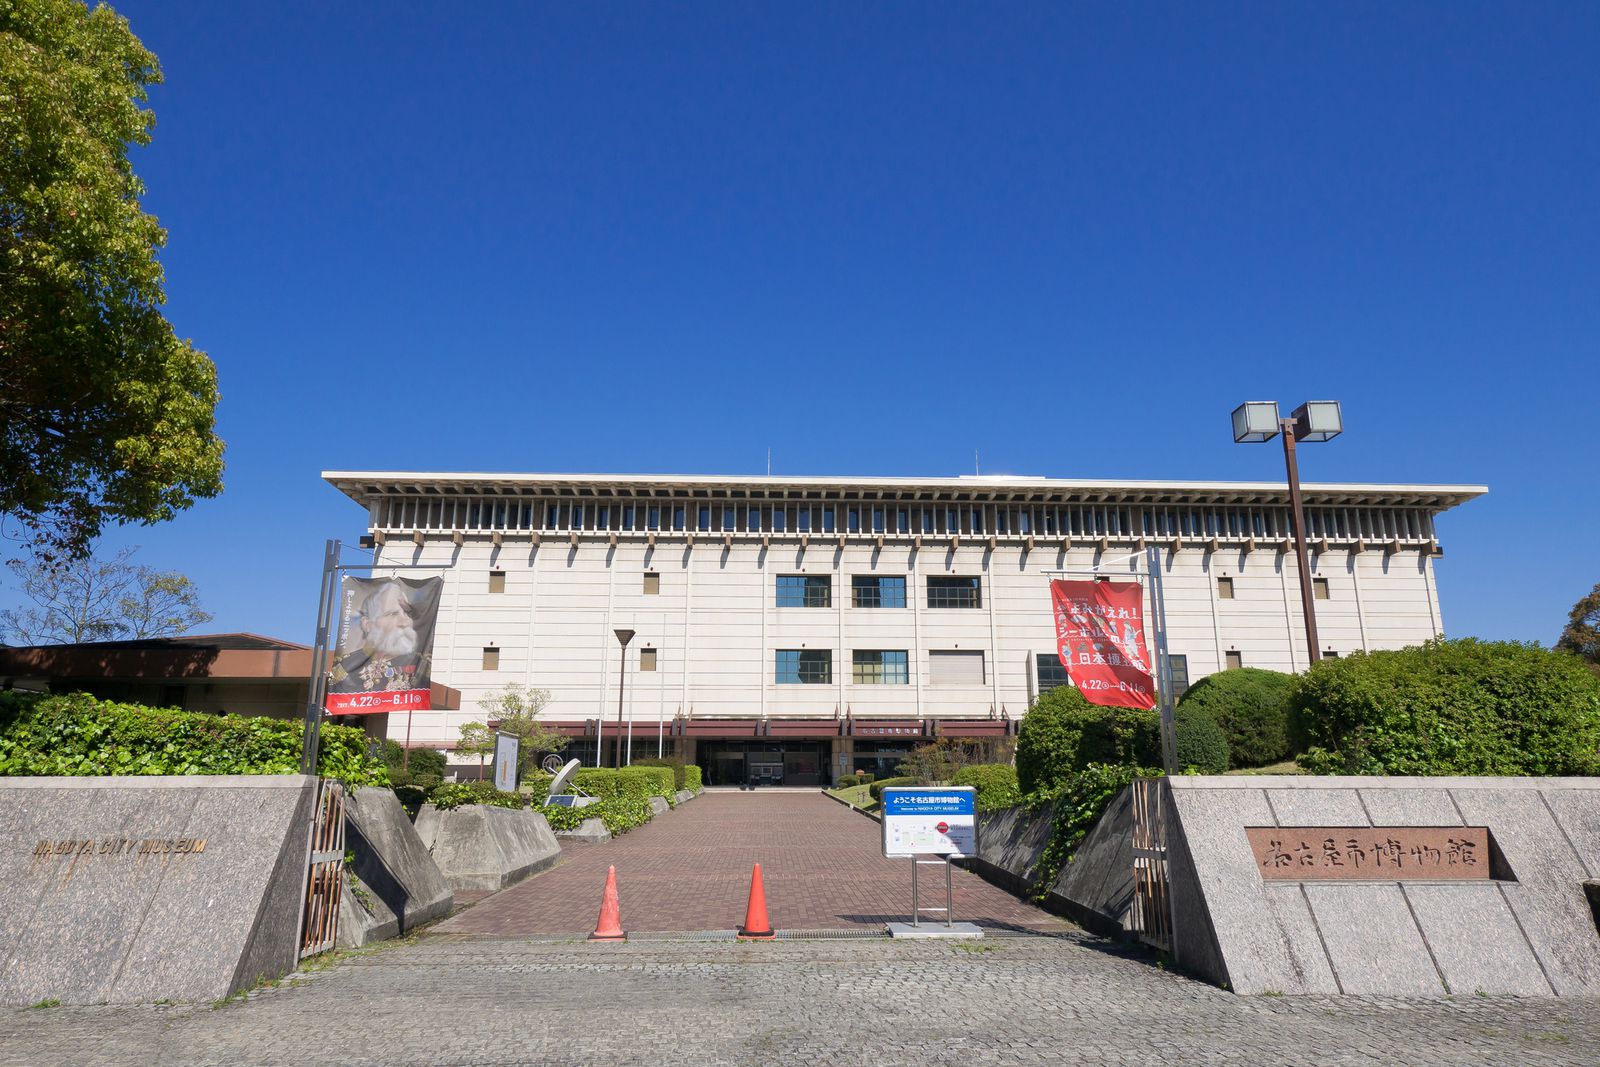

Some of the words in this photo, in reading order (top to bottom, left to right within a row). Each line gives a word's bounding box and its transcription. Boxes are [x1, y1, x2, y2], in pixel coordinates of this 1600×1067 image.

[893, 796, 966, 804] ようこそ名古屋市博物館へ
[33, 839, 95, 855] NAGOYA
[99, 838, 138, 855] CITY
[138, 836, 208, 855] MUSEUM
[1263, 838, 1477, 869] 名古屋市博物館
